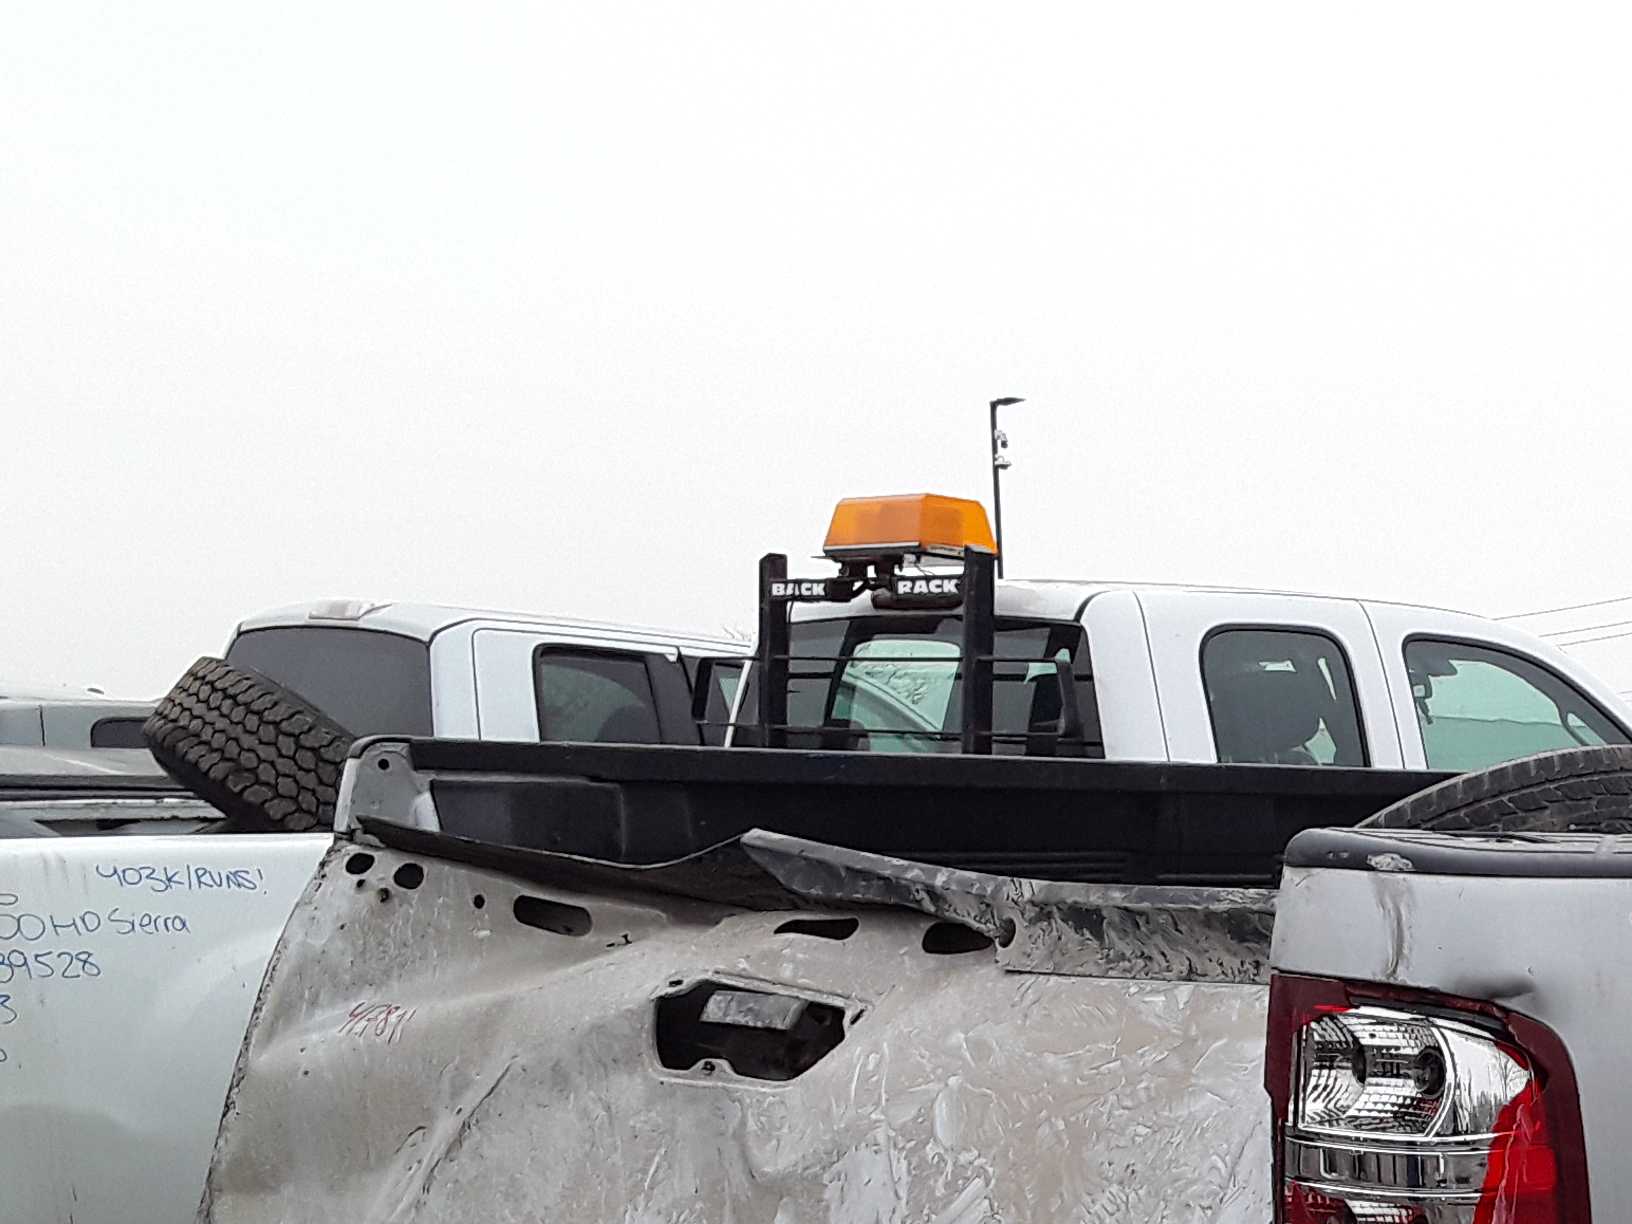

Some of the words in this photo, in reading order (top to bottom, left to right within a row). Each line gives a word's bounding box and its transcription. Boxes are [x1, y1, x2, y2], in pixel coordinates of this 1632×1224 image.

[771, 582, 826, 597] BACK
[896, 578, 961, 595] RACK
[108, 907, 192, 936] Sierra
